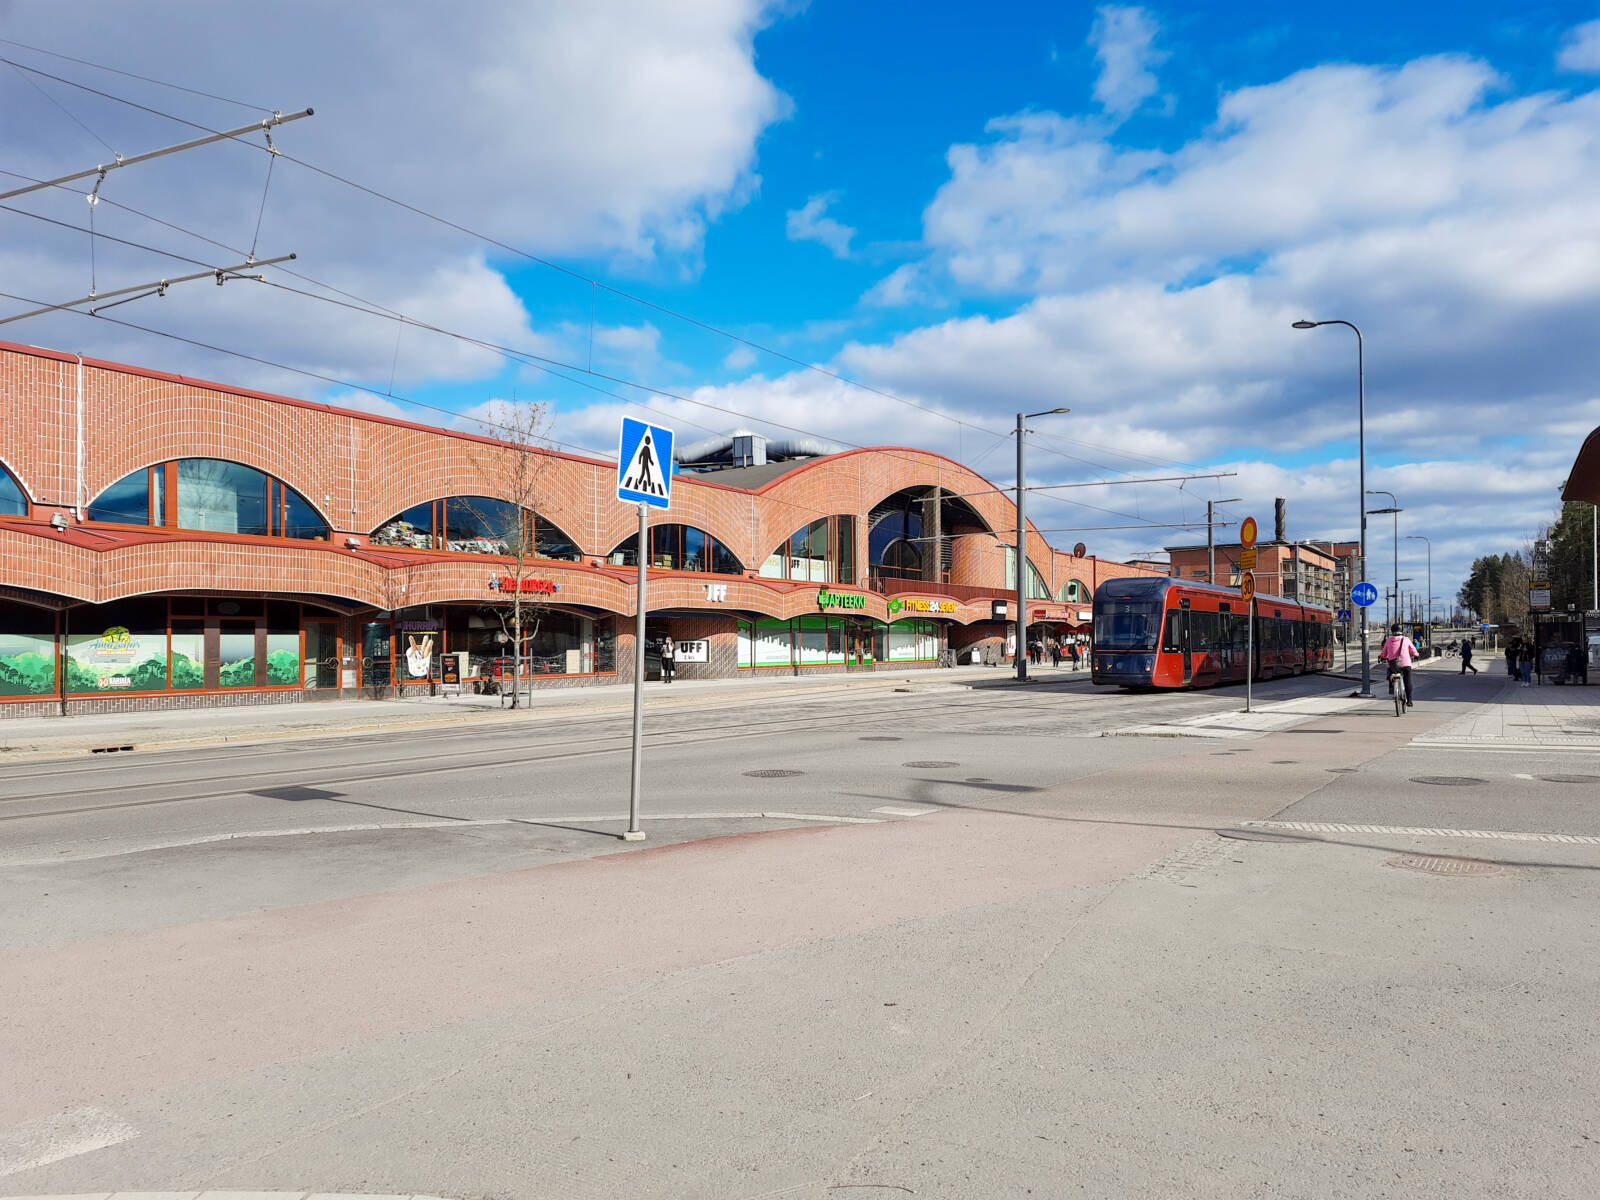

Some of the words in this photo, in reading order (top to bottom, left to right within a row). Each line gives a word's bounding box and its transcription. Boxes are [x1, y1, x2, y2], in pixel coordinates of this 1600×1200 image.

[1244, 579, 1252, 595] 30
[829, 594, 866, 608] APTEEKKI
[1124, 605, 1130, 613] 3
[681, 642, 703, 653] UFF
